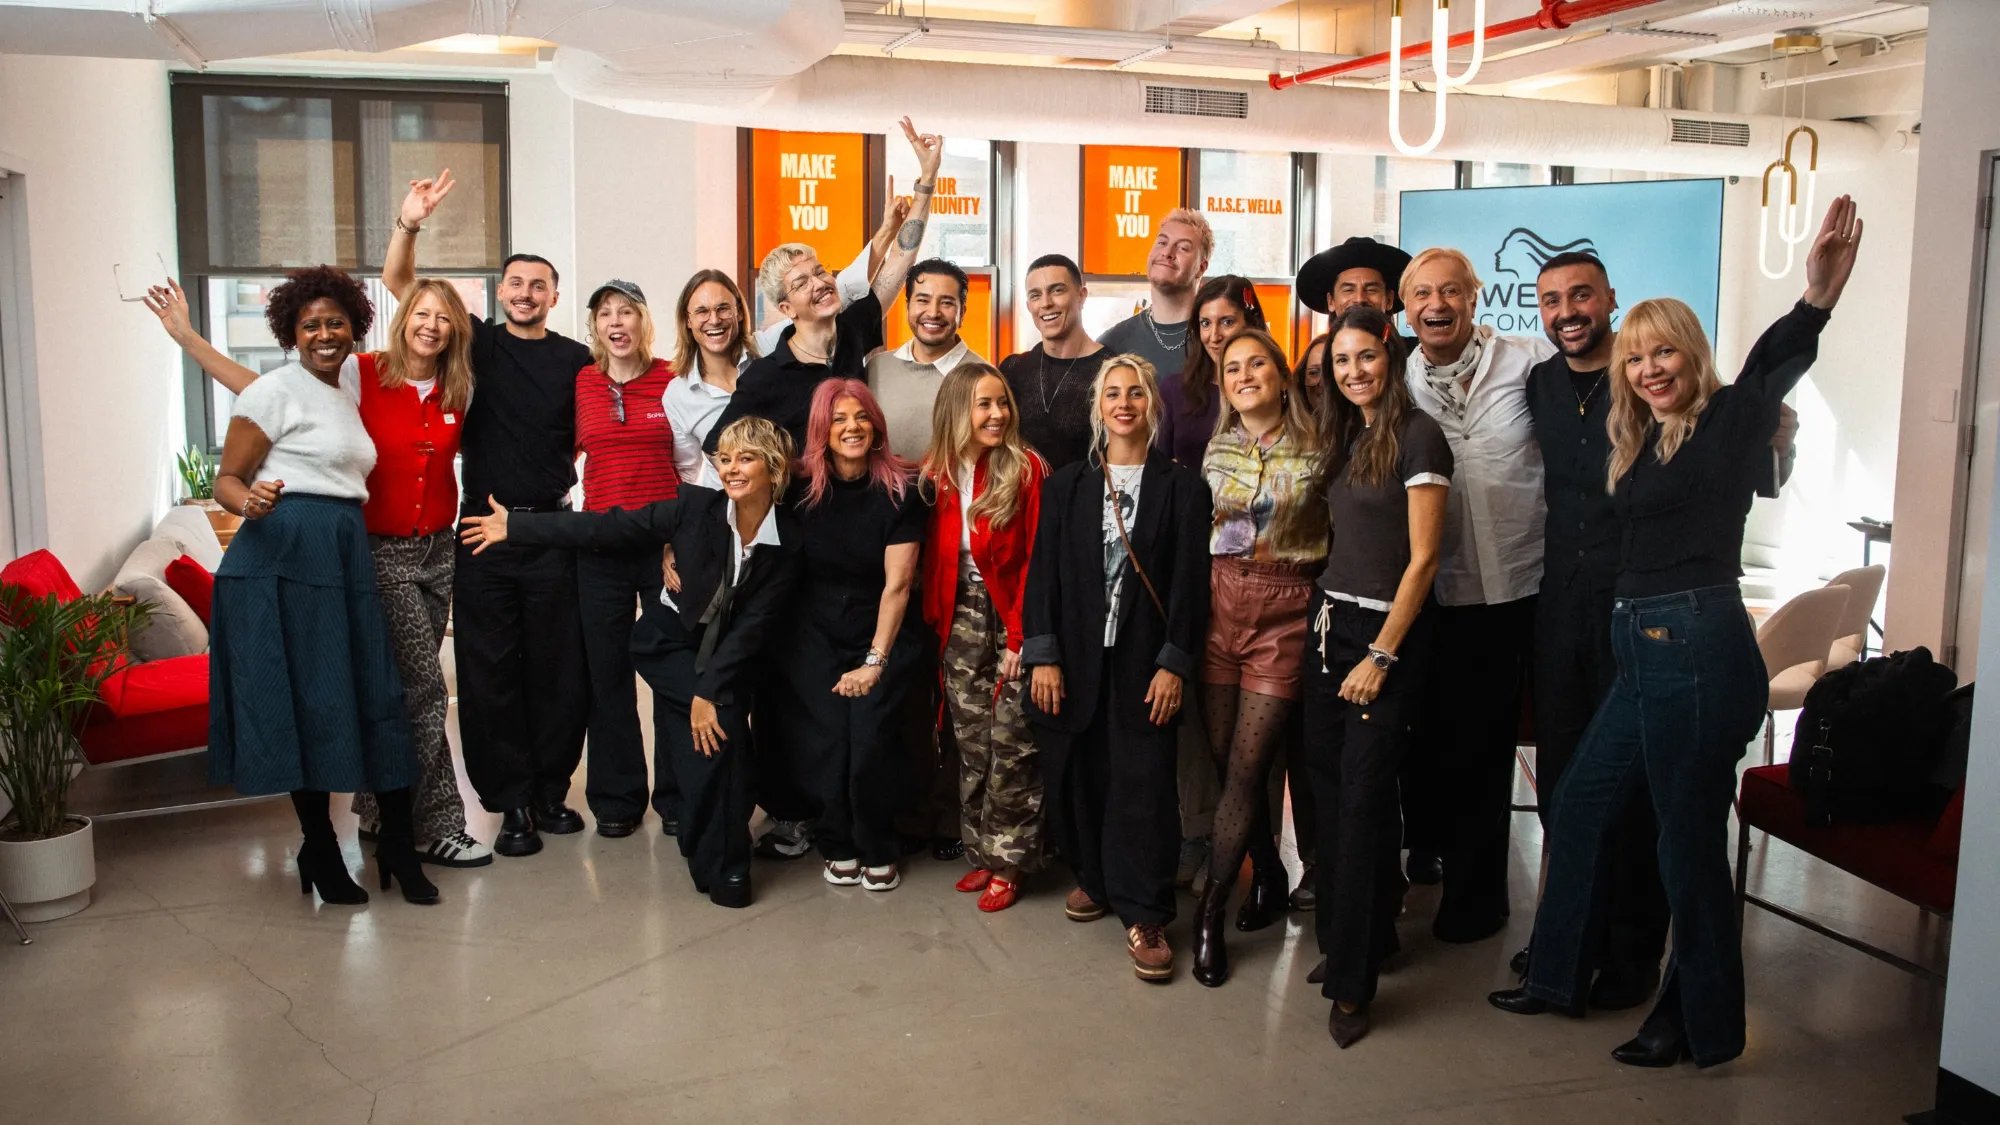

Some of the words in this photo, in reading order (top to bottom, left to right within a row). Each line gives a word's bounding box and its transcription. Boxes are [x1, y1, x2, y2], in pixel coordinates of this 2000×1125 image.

[780, 153, 837, 179] MAKE
[1109, 165, 1158, 190] MAKE
[799, 180, 818, 204] IT
[1125, 190, 1142, 213] IT
[1207, 197, 1245, 213] R.I.S.E.
[1248, 199, 1282, 214] WELLA
[788, 205, 828, 231] YOU
[1115, 214, 1150, 238] YOU
